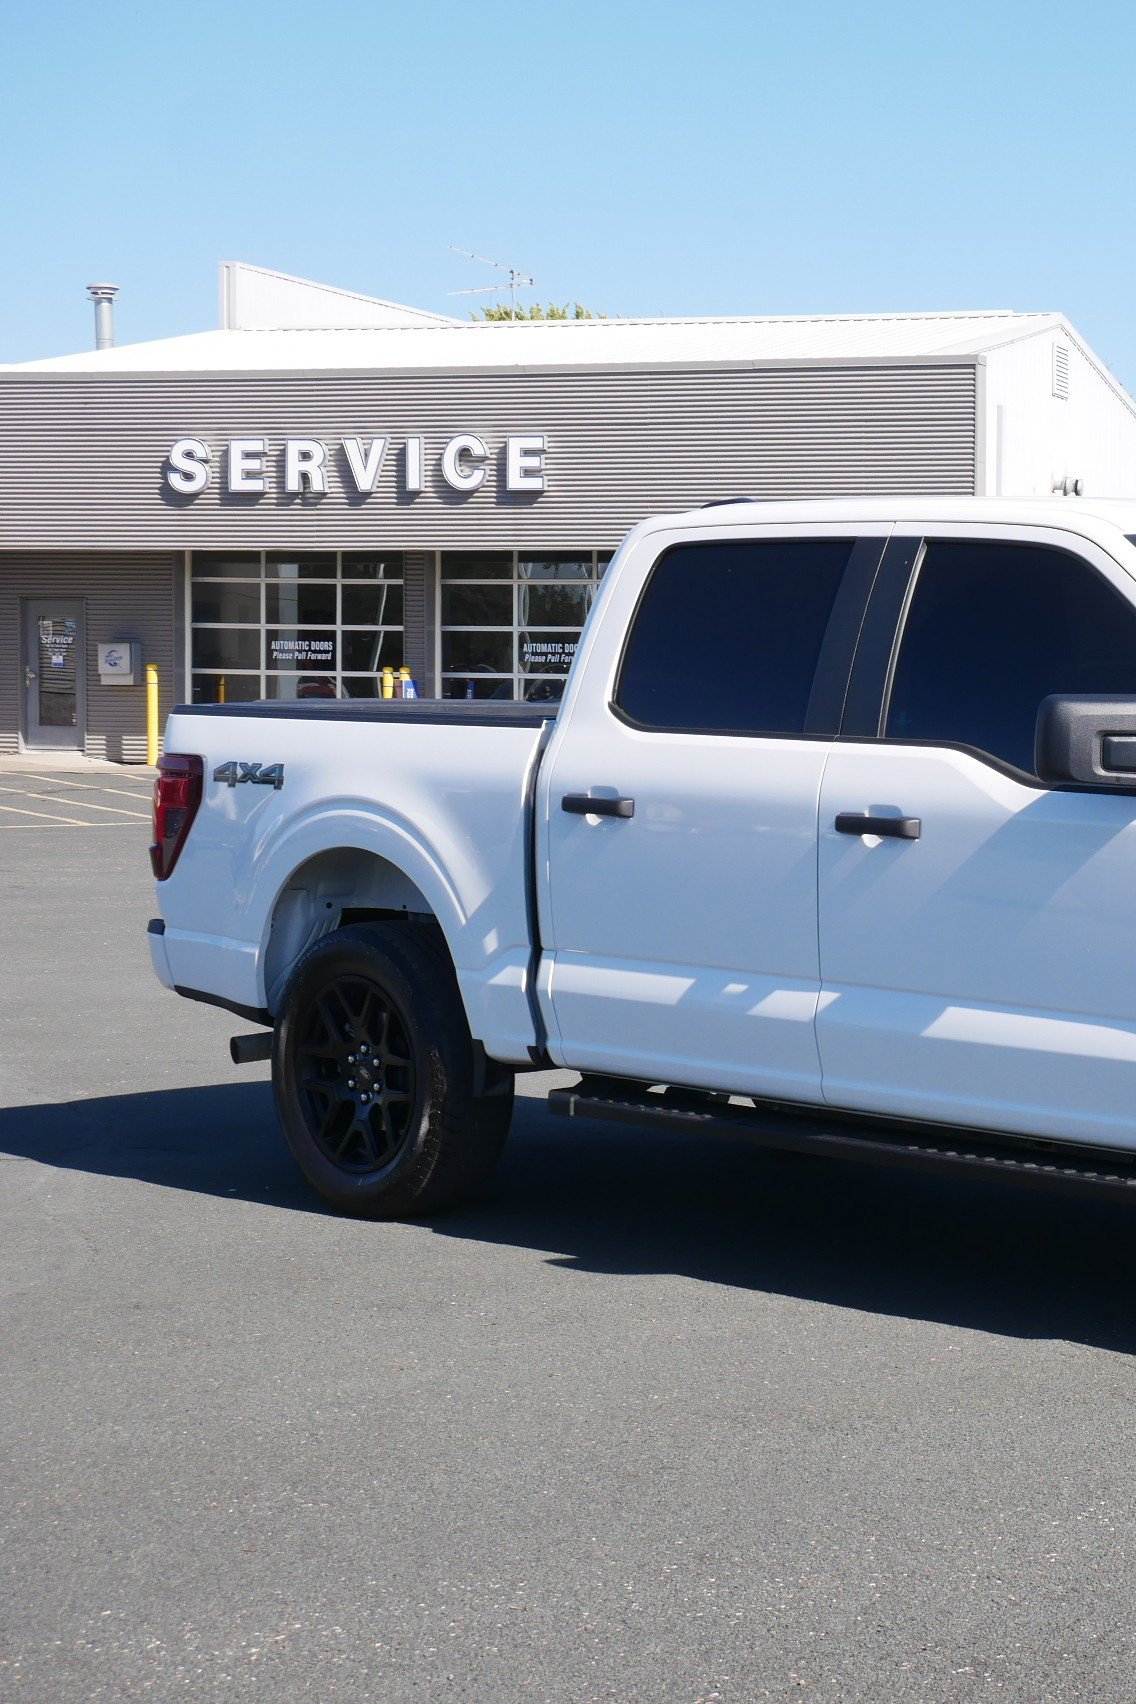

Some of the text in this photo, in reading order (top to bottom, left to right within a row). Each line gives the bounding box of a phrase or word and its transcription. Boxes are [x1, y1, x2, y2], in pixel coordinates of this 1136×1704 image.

[166, 433, 549, 494] SERVICE
[41, 635, 74, 644] Service
[271, 640, 333, 650] AUTOMATIC DOORS
[523, 643, 563, 652] AUTOMATIC
[272, 651, 332, 660] Please Pull Forward
[524, 653, 546, 662] Please
[546, 654, 560, 663] Pull
